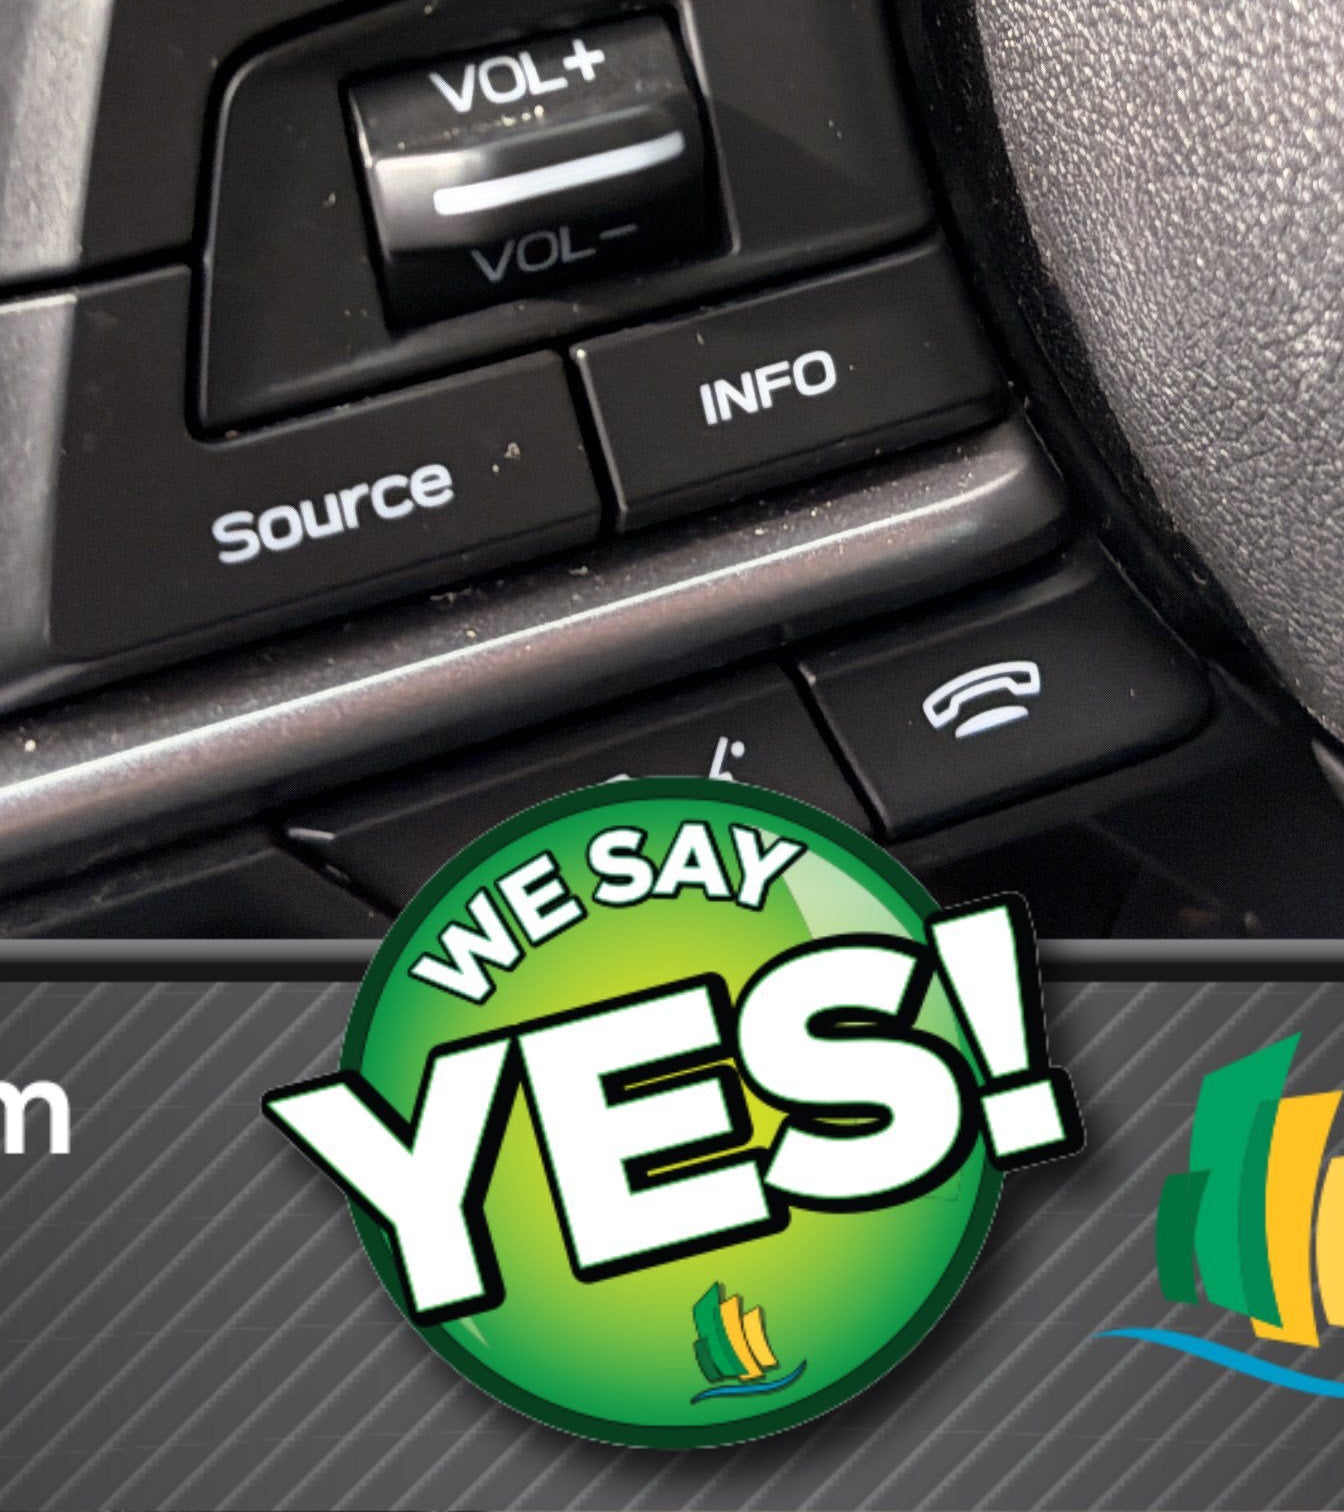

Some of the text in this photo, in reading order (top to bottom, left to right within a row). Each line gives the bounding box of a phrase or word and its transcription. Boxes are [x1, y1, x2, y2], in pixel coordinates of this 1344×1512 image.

[430, 39, 606, 113] VOL+
[699, 349, 838, 426] INFO
[211, 464, 454, 565] Source
